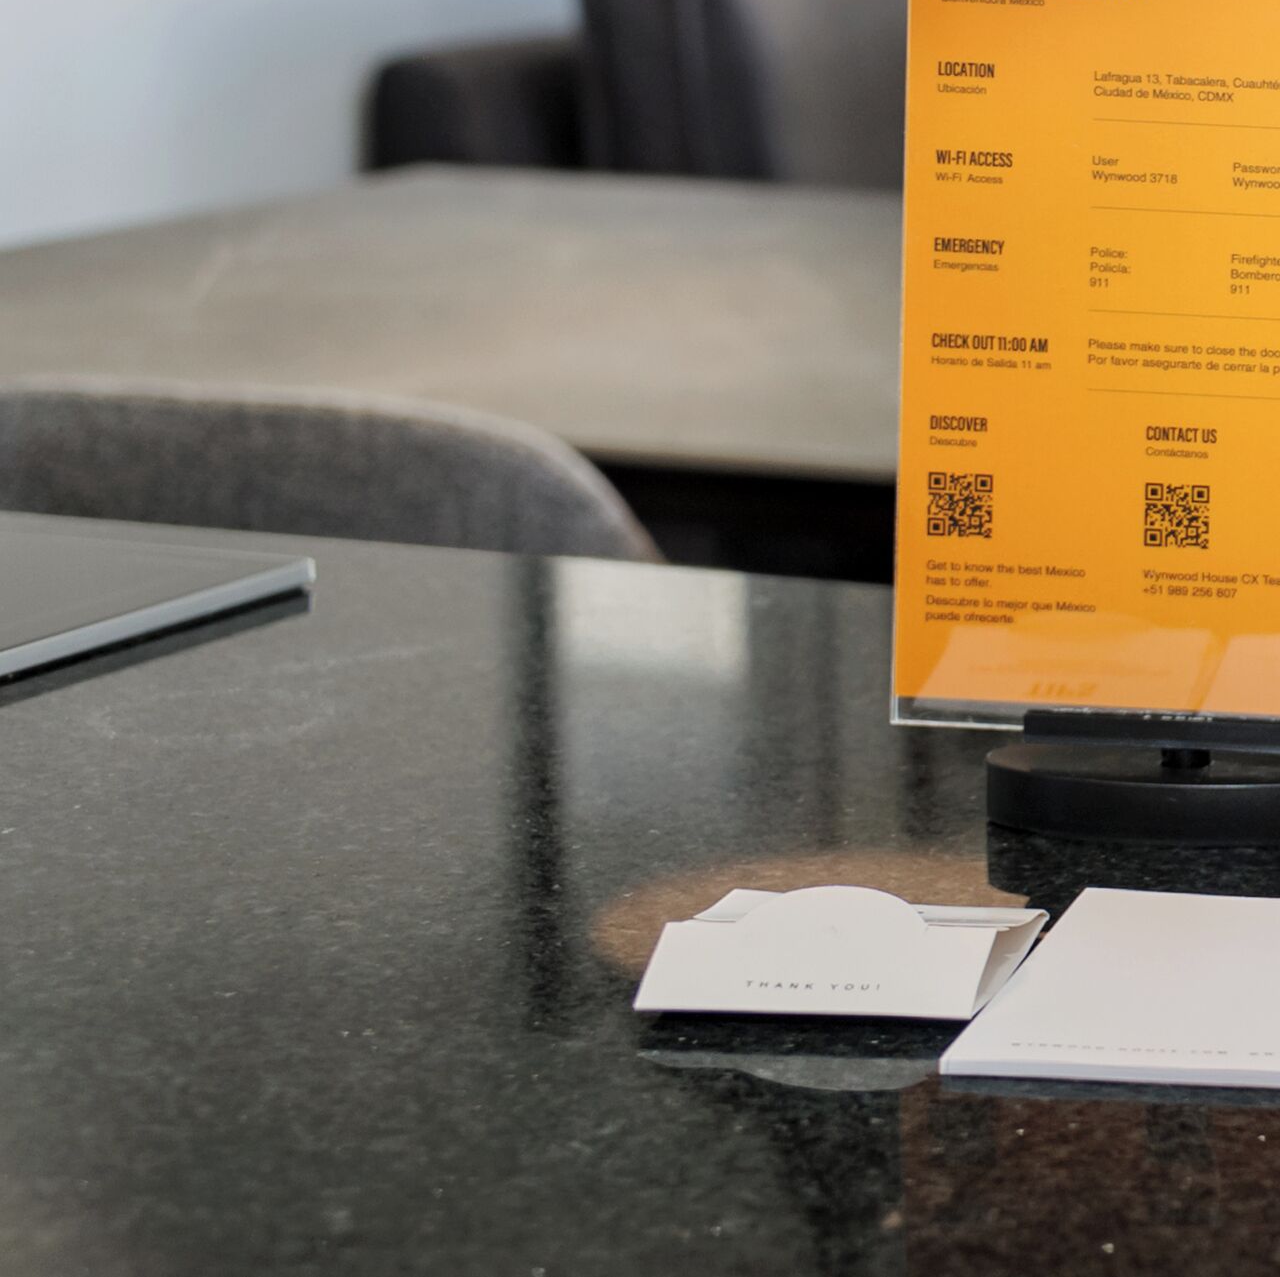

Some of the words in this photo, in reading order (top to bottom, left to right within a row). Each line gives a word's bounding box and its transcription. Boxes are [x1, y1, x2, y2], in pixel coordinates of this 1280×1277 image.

[938, 61, 995, 78] LOCATION
[1094, 71, 1142, 85] Lafragua
[1146, 74, 1162, 85] 13,
[1166, 74, 1229, 88] Tabacalera,
[938, 83, 987, 95] Ubicación
[1093, 86, 1133, 98] Ciudad
[1135, 89, 1149, 98] de
[1152, 89, 1195, 102] México,
[1197, 91, 1234, 102] CDMX
[936, 149, 966, 165] WI-FI
[969, 152, 1013, 168] ACCESS
[1092, 155, 1119, 166] User
[935, 172, 962, 182] Wi-Fi
[967, 174, 1004, 185] Access
[1092, 170, 1147, 183] Wynwood
[1150, 174, 1178, 184] 3718
[934, 237, 1005, 255] EMERGENCY
[1090, 247, 1128, 259] Police:
[933, 259, 999, 272] Emergencias
[1090, 262, 1131, 274] Policía:
[1089, 277, 1110, 287] 911
[1230, 284, 1250, 294] 911
[932, 333, 969, 348] CHECK
[972, 335, 994, 350] OUT
[998, 337, 1026, 351] 11:00
[1029, 338, 1048, 353] AM
[1088, 339, 1127, 350] Please
[1129, 342, 1160, 352] make
[1163, 345, 1188, 353] sure
[1192, 345, 1202, 354] to
[1206, 345, 1236, 356] close
[1239, 347, 1256, 357] the
[931, 356, 969, 366] Horario
[971, 358, 984, 367] de
[986, 358, 1018, 369] Salida
[1022, 360, 1032, 369] 11
[1035, 362, 1052, 370] am
[1087, 354, 1107, 365] Por
[1110, 356, 1139, 367] favor
[1142, 358, 1202, 372] asegurarte
[1206, 360, 1220, 371] de
[1223, 363, 1257, 373] cerrar
[1259, 363, 1270, 373] la
[930, 415, 988, 432] DISCOVER
[929, 436, 978, 447] Descubre
[1146, 426, 1199, 443] CONTACT
[1202, 429, 1217, 444] US
[1145, 447, 1209, 459] Contáctanos
[926, 559, 947, 571] Get
[950, 562, 961, 572] to
[964, 562, 993, 573] know
[997, 563, 1015, 574] the
[1018, 565, 1042, 575] best
[1045, 566, 1086, 578] Mexico
[926, 575, 946, 586] has
[950, 576, 961, 587] to
[1143, 569, 1199, 582] Wynwood
[1201, 572, 1238, 584] House
[1241, 573, 1259, 585] CX
[1143, 584, 1163, 594] +51
[1167, 585, 1188, 596] 989
[1192, 586, 1212, 597] 256
[926, 594, 980, 607] Descubre
[983, 597, 993, 607] lo
[996, 599, 1028, 612] mejor
[1032, 601, 1053, 611] que
[1056, 601, 1096, 613] México
[925, 610, 960, 621] puede
[746, 980, 814, 991] THANK
[830, 983, 880, 991] YOU!
